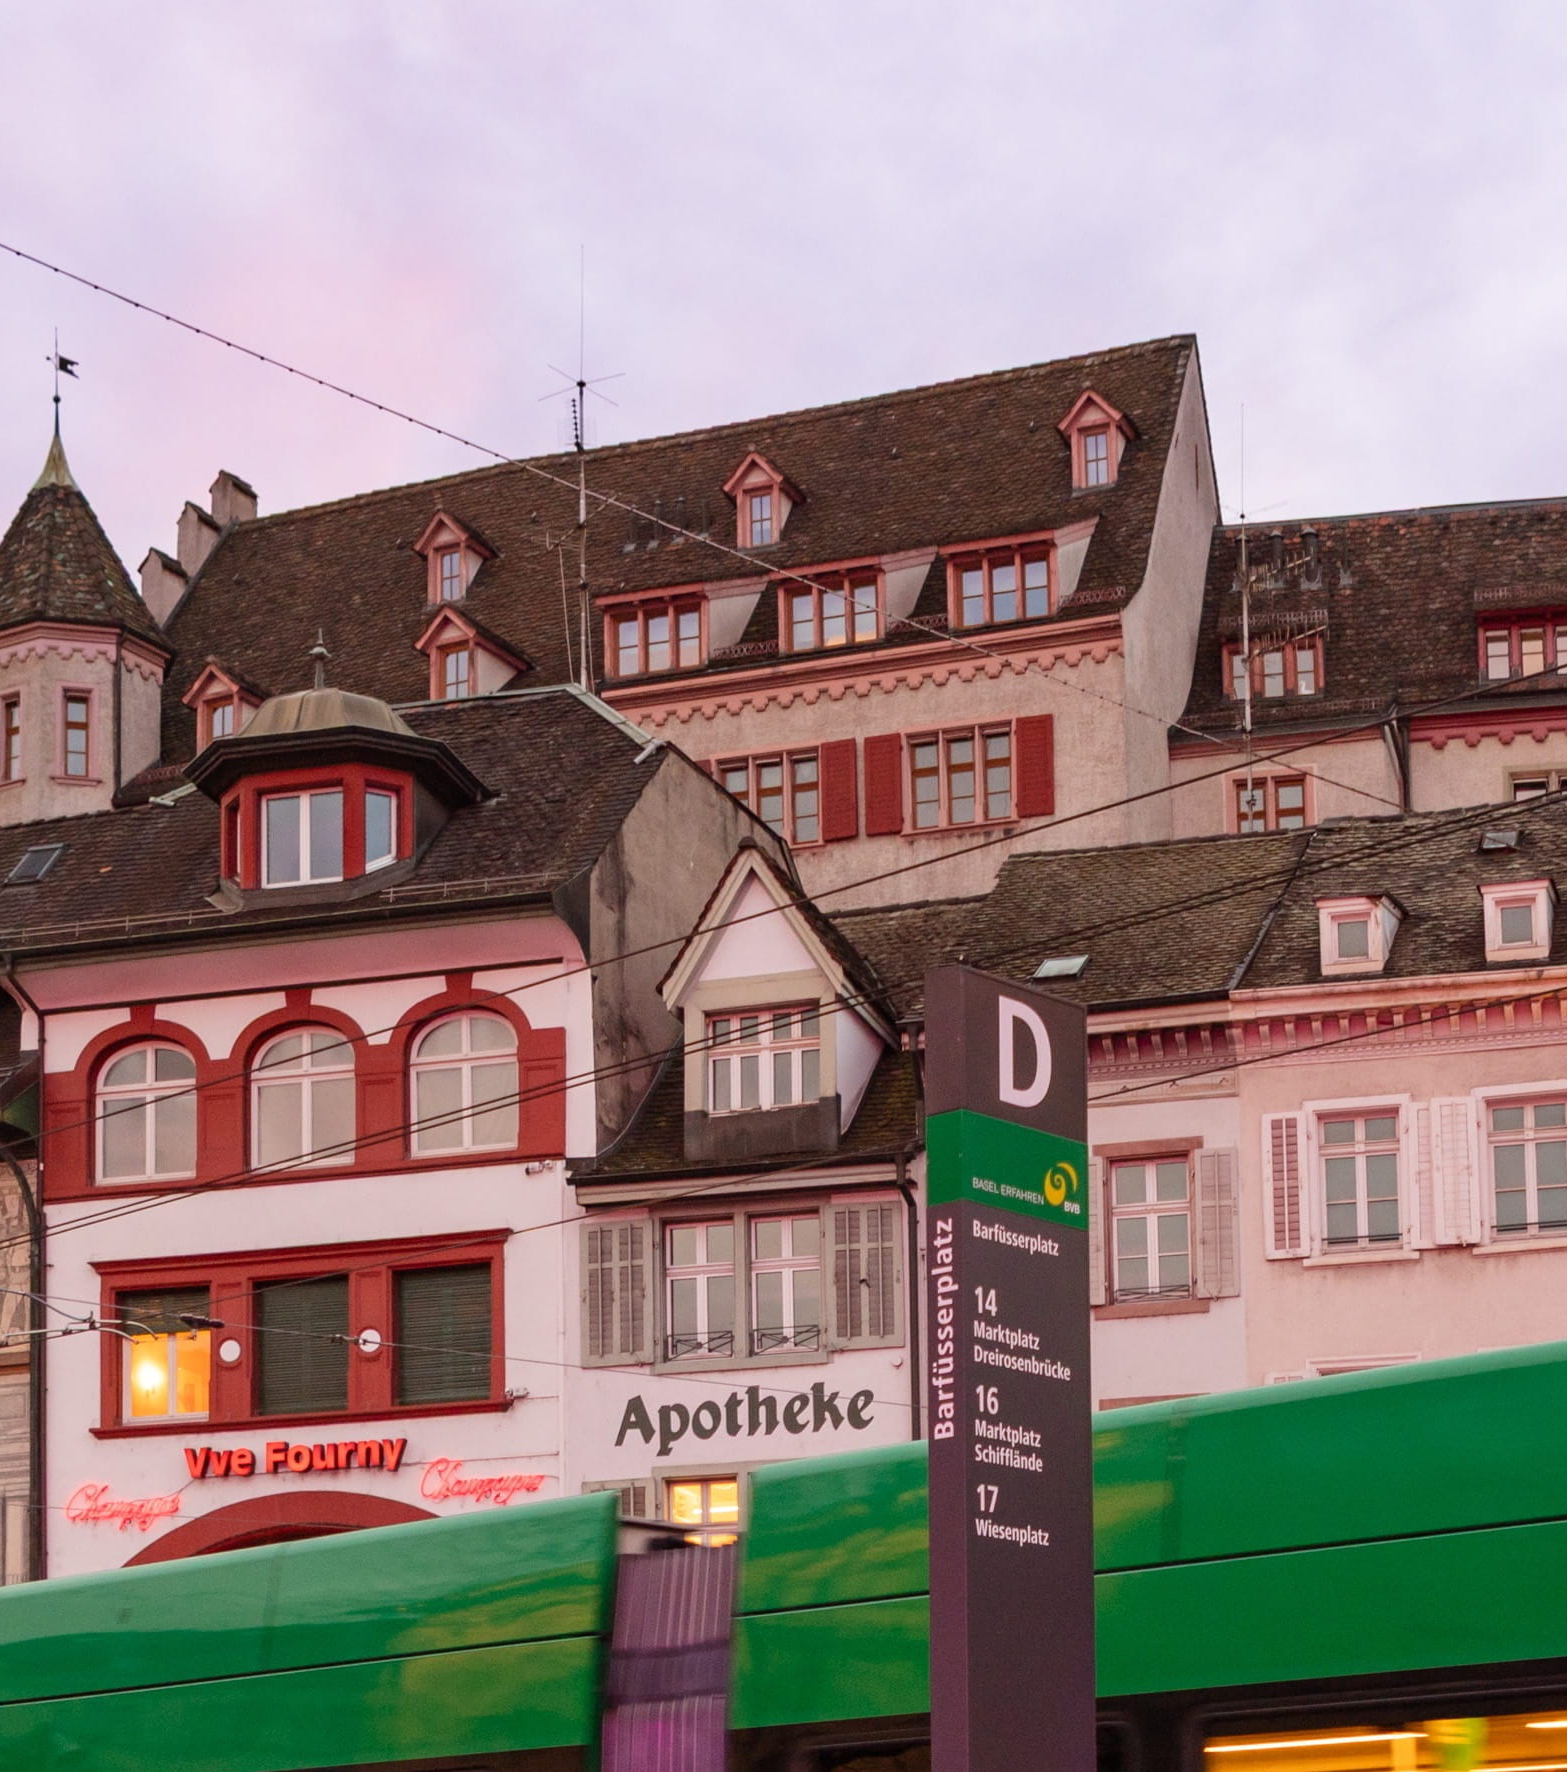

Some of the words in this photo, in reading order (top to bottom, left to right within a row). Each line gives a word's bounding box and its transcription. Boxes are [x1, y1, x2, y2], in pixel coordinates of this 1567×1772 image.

[998, 994, 1052, 1108] D
[972, 1177, 1000, 1194] BASEL
[1000, 1184, 1044, 1205] ERFAHREN
[1064, 1201, 1081, 1215] BVB
[972, 1219, 1060, 1257] Barfüsserplatz
[974, 1286, 999, 1317] 14
[930, 1217, 960, 1440] Barfüsserplatz
[973, 1320, 1041, 1351] Marktplatz
[973, 1345, 1072, 1382] Dreirosenbrücke
[975, 1385, 1000, 1415] 16
[614, 1382, 875, 1457] Apotheke
[974, 1419, 1042, 1449] Marktplatz
[184, 1447, 256, 1479] Vve
[265, 1438, 407, 1475] Fourny
[974, 1444, 1044, 1473] Schifflände
[976, 1483, 1000, 1514] 17
[975, 1517, 1050, 1547] Wiesenplatz
